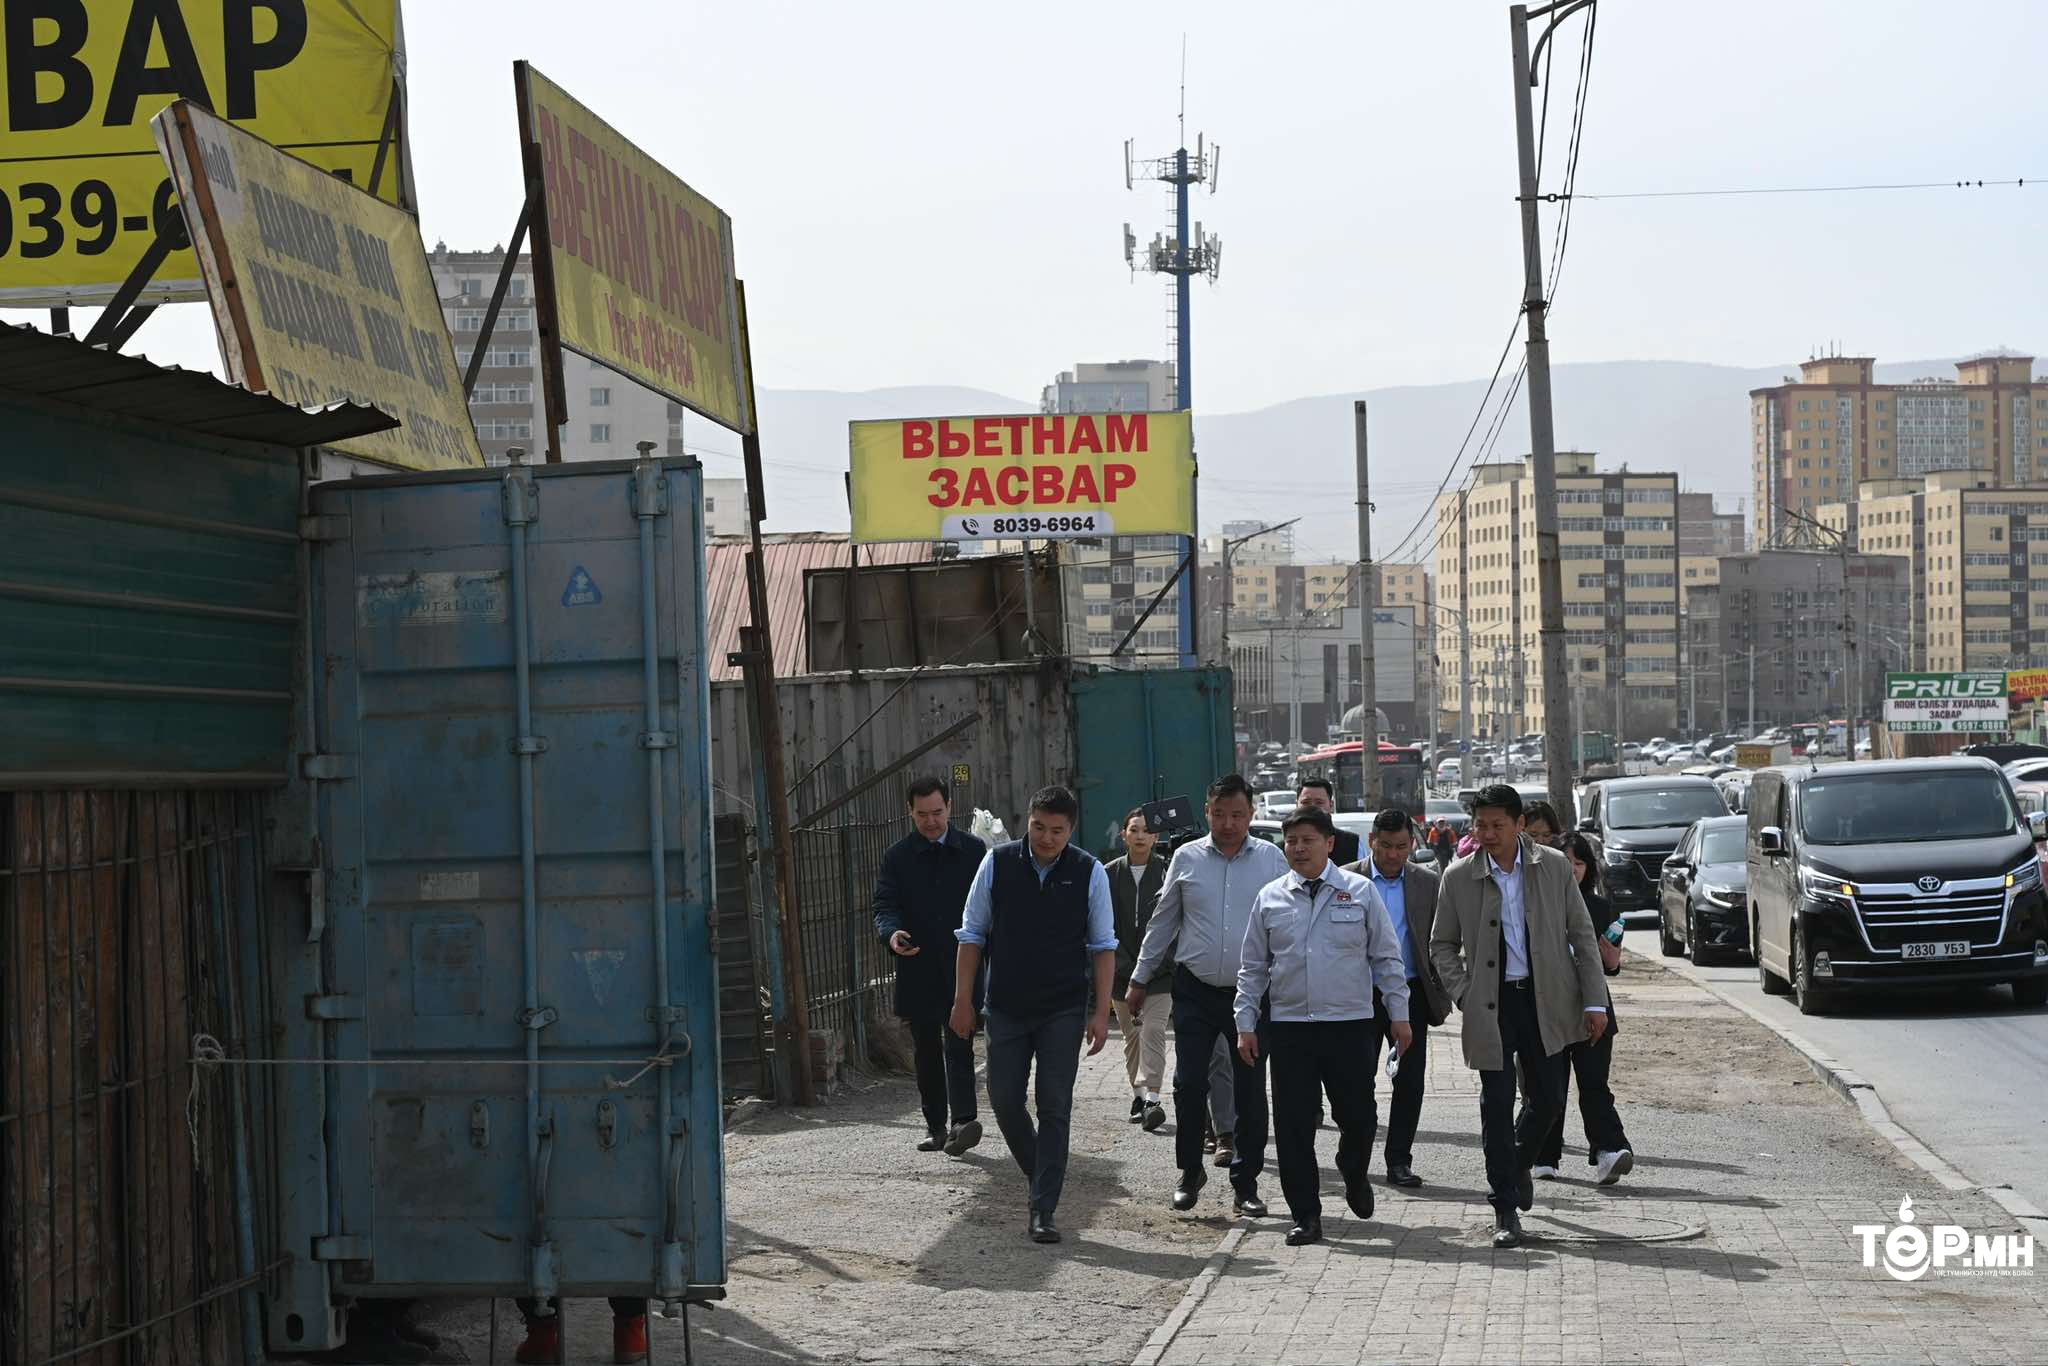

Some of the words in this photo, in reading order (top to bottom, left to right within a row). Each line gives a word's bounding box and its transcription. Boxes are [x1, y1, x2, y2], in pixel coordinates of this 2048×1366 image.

[4, 0, 308, 131] ВАР
[538, 103, 654, 303] ВЬЕТНАМ
[648, 181, 722, 345] ЗАСВАР
[901, 414, 1149, 459] ВЬЕТНАМ
[927, 463, 1137, 508] ЗАСВАР
[993, 515, 1096, 533] 8039-6964
[1890, 679, 2003, 697] PRIUS
[1894, 700, 1916, 709] ЯПОН
[1918, 700, 1950, 709] СЭЛБЭГ
[1929, 710, 1962, 719] ЗАСВАР
[1907, 943, 1936, 957] 2830
[1944, 943, 1965, 954] УБЗ
